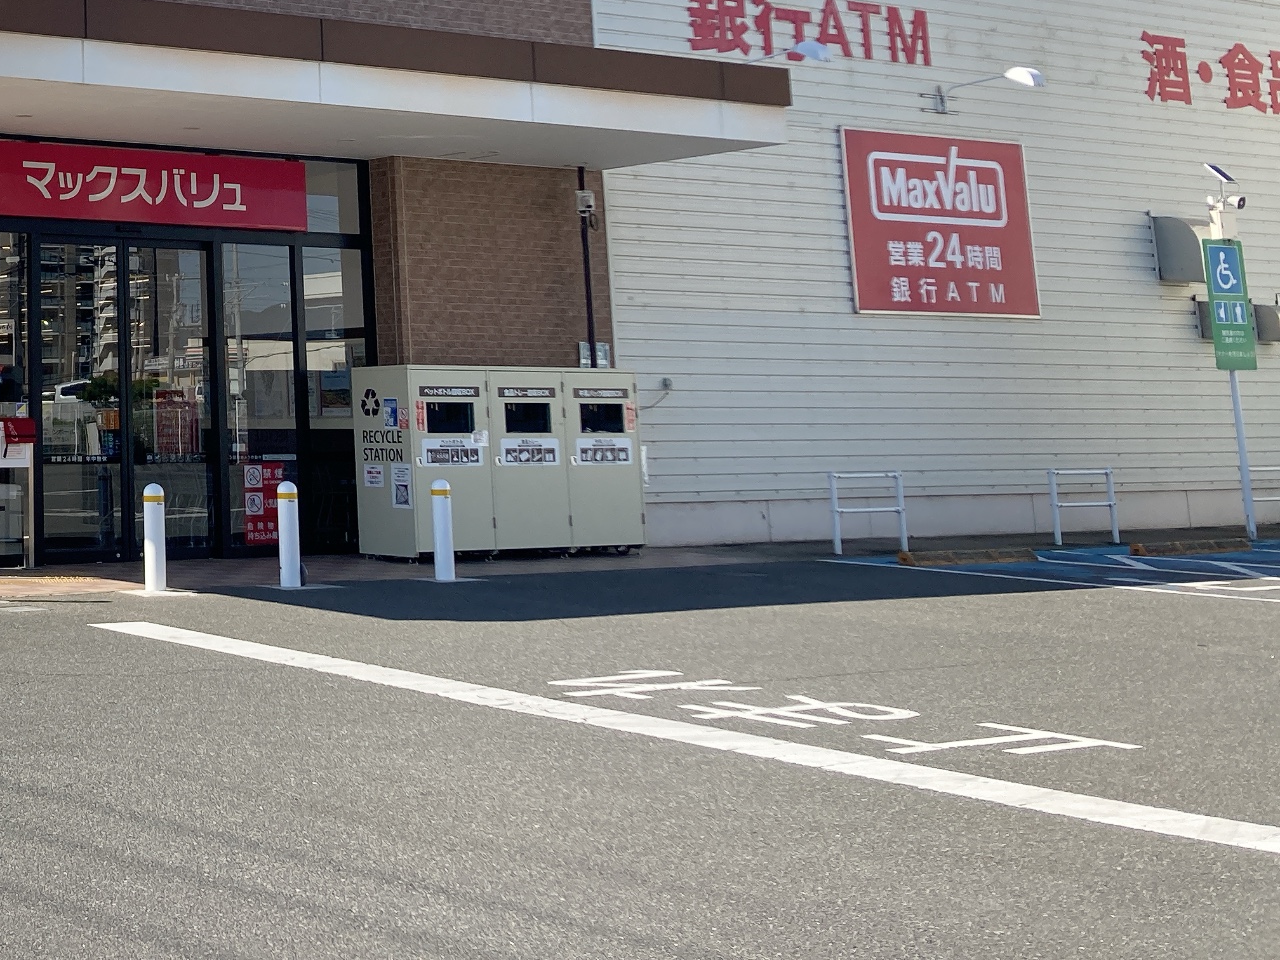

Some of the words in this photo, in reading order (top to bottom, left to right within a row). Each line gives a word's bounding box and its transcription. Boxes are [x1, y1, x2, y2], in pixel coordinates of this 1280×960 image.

[1140, 30, 1280, 114] 酒・食
[22, 160, 246, 212] マックスバリュ
[879, 146, 997, 213] MaxValu
[887, 231, 1003, 271] 営業24時間
[362, 430, 403, 444] RECYCLE
[363, 447, 404, 462] STATION
[547, 670, 1144, 755] 止まれ
